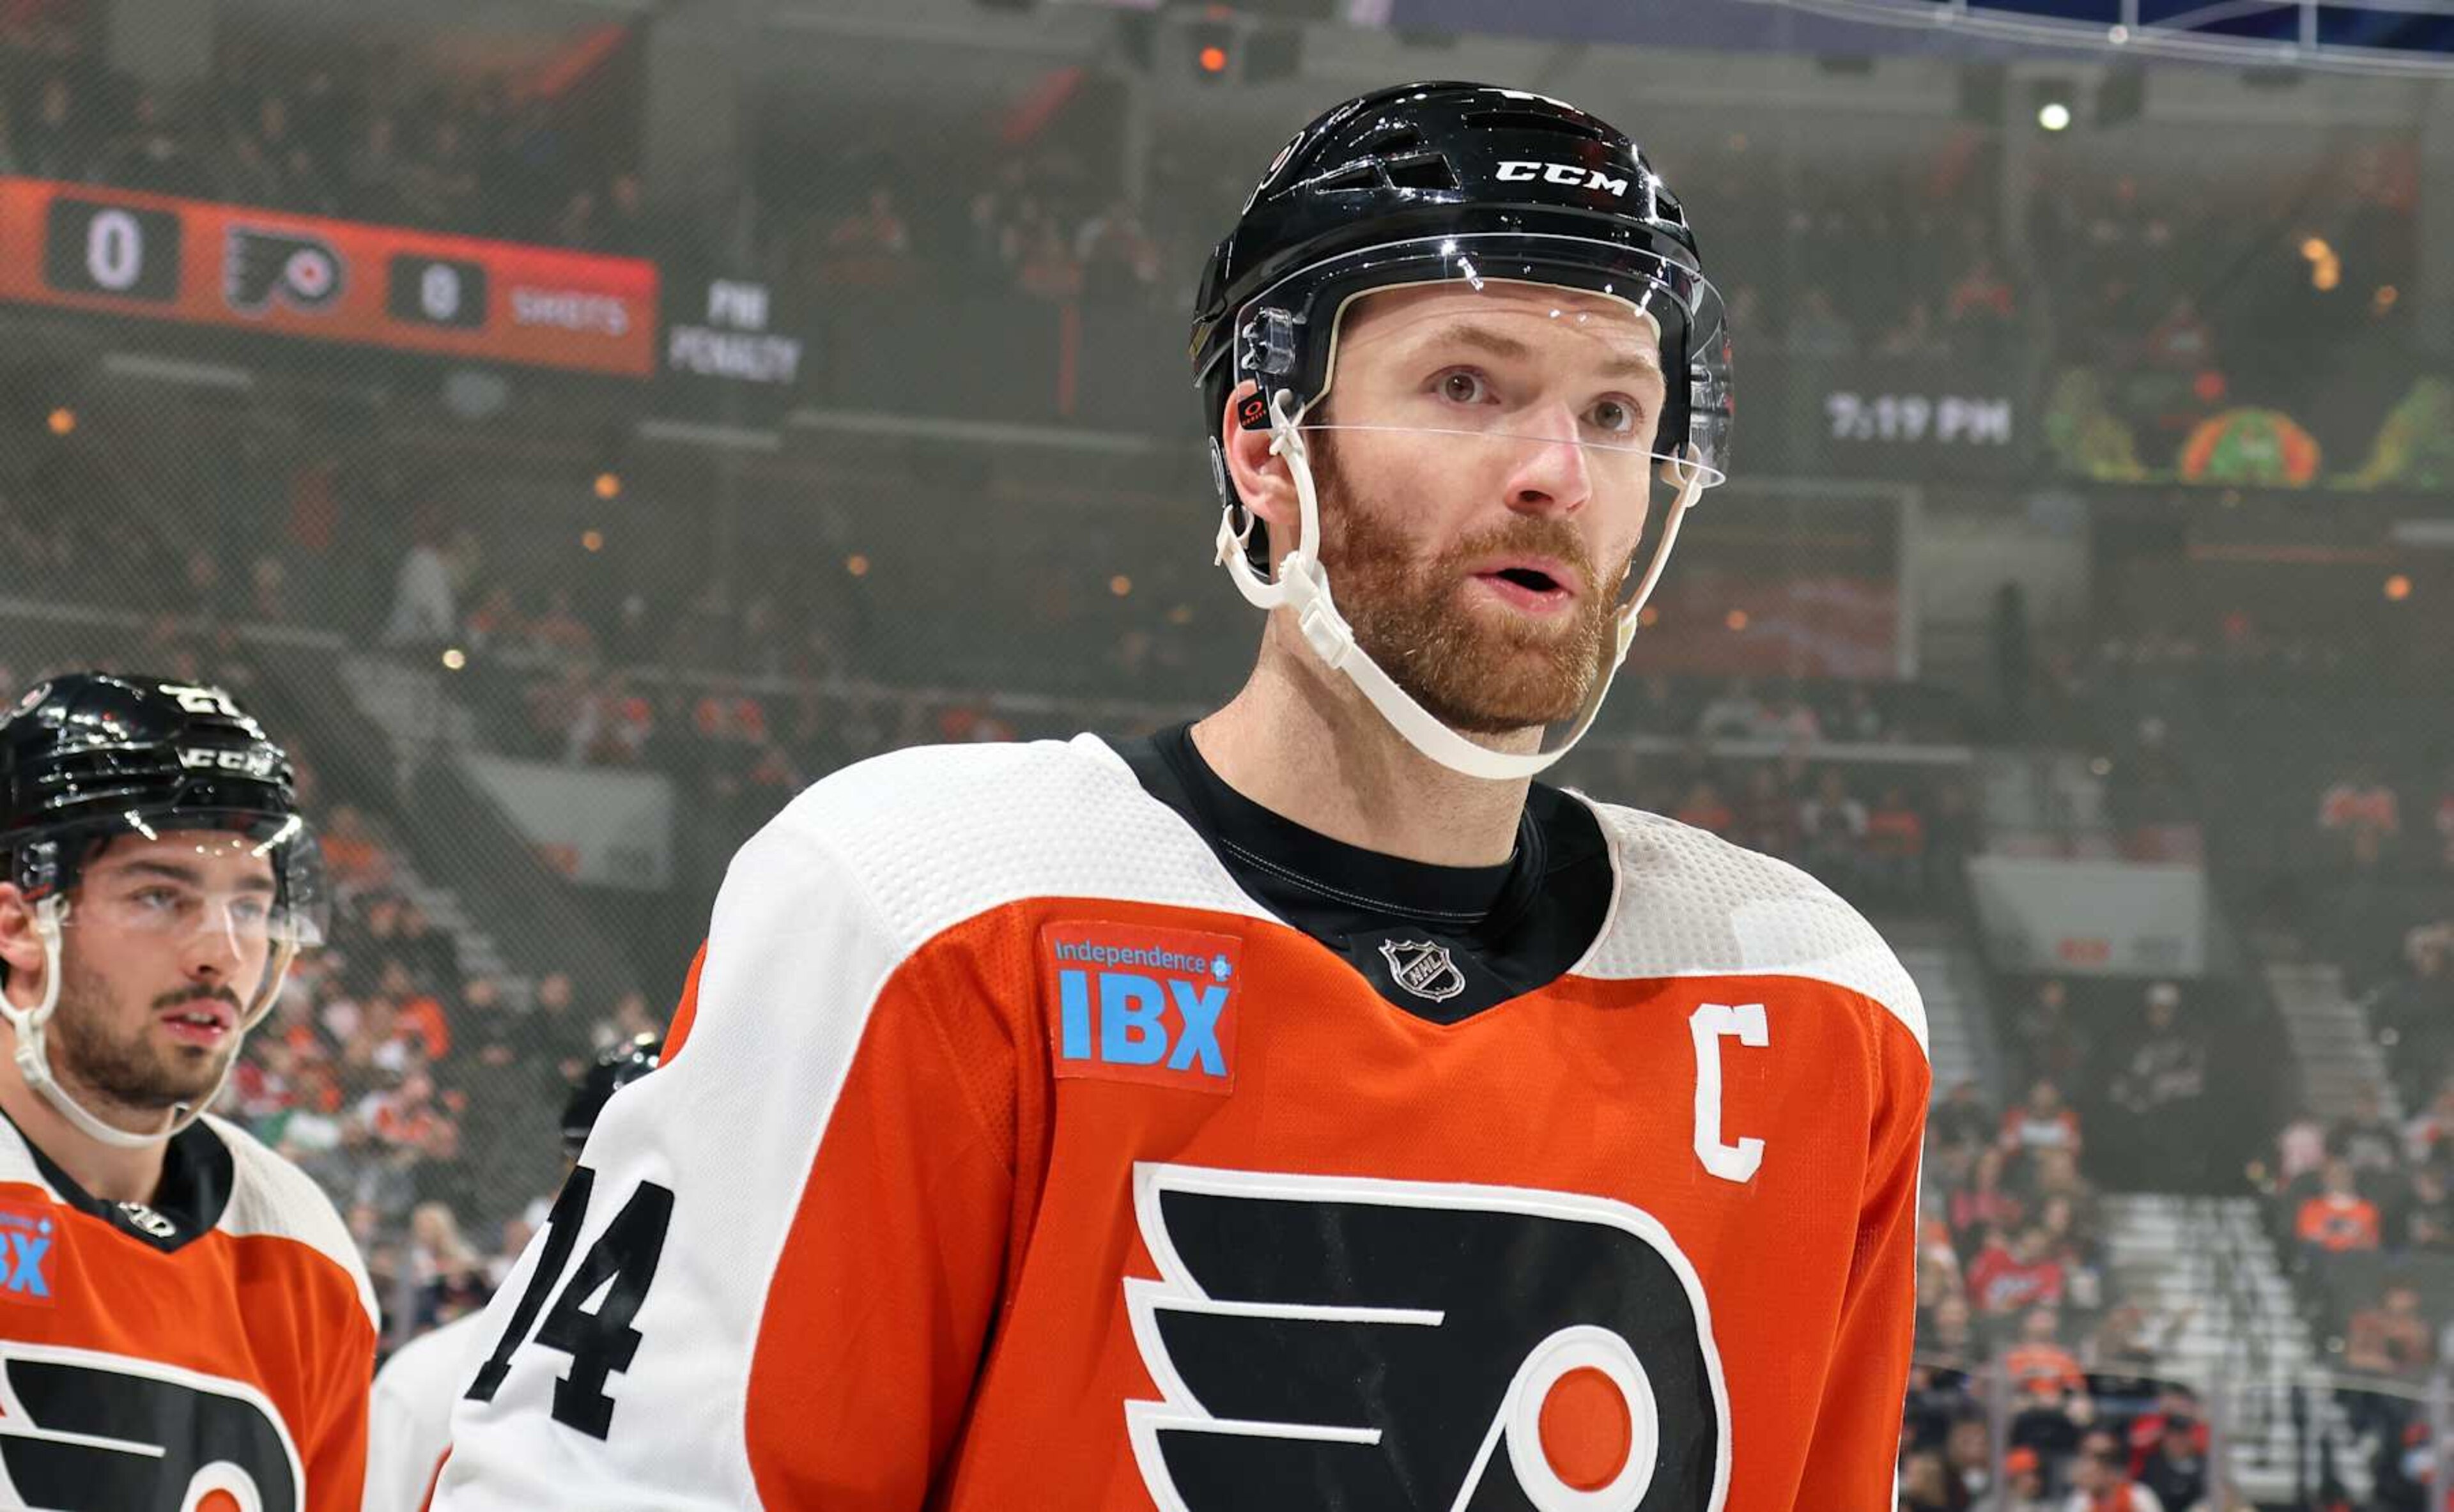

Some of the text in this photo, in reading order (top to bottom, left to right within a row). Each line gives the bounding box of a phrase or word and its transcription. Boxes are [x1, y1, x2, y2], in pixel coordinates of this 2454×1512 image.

[1495, 161, 1629, 197] CCM
[87, 208, 141, 290] 0
[1826, 392, 2010, 444] 7:19 PM
[1056, 939, 1206, 973] Independence
[1408, 955, 1442, 986] NHL
[1060, 970, 1230, 1077] IBX
[1688, 1003, 1770, 1184] C
